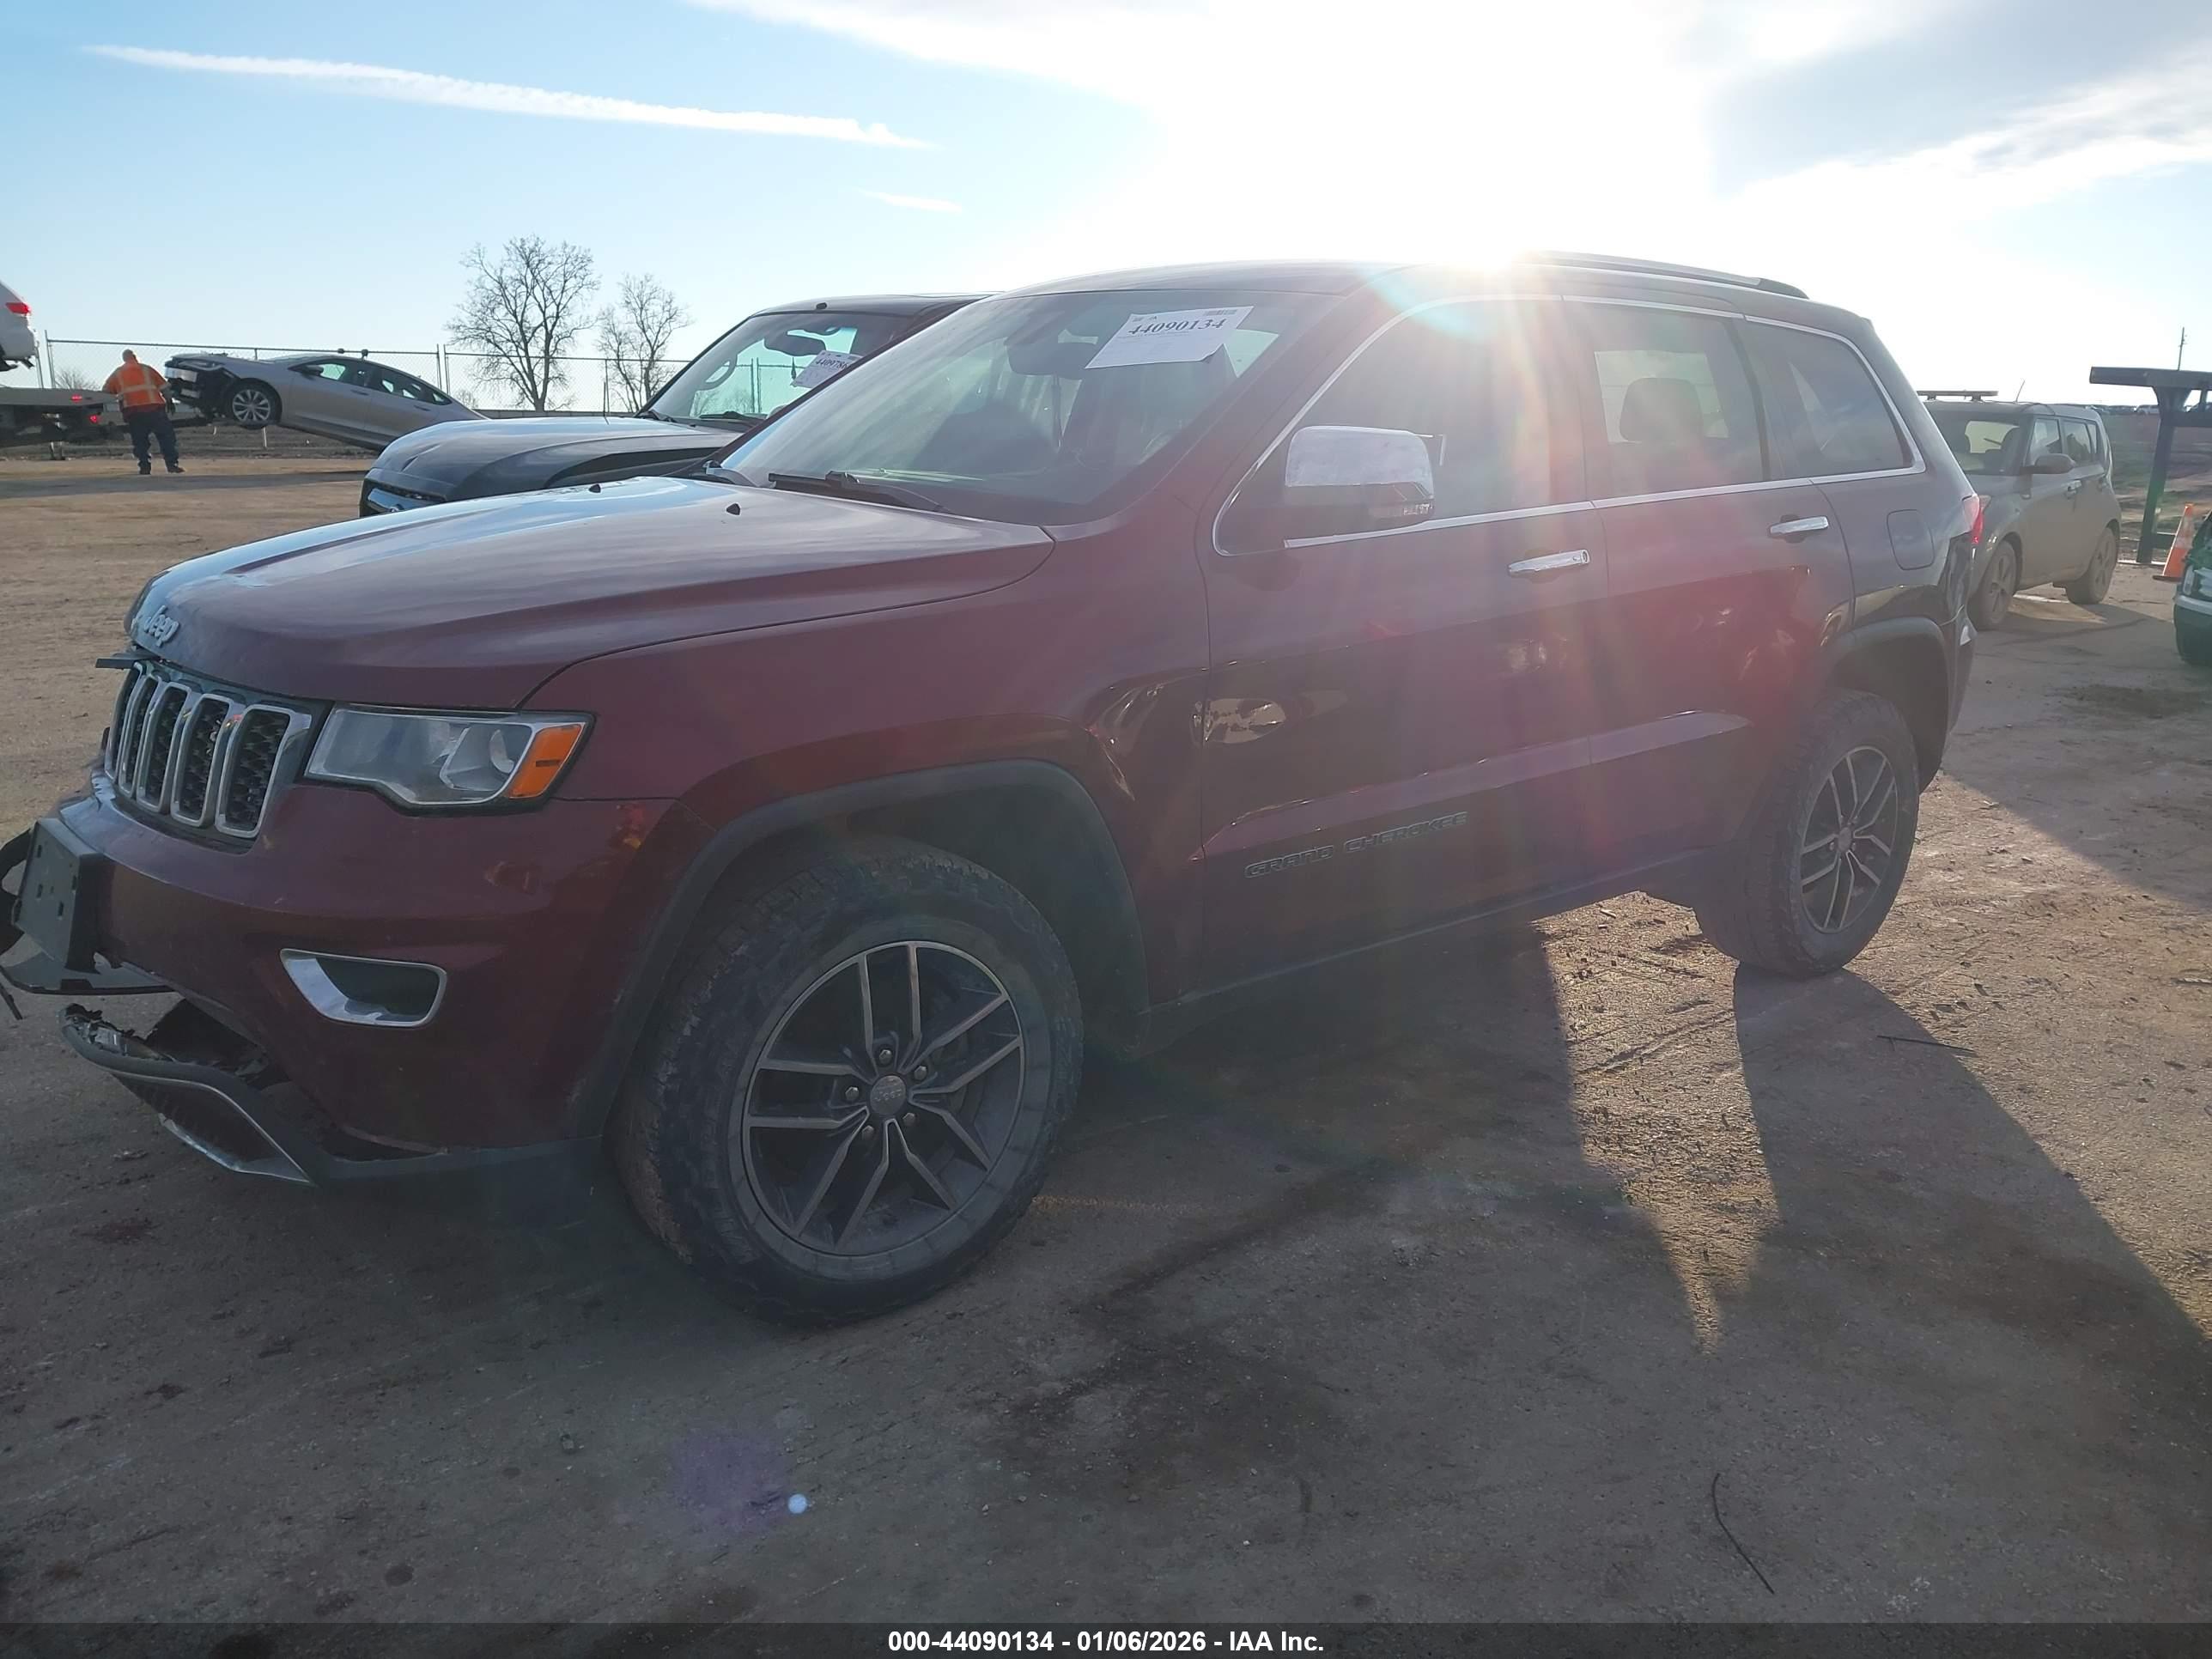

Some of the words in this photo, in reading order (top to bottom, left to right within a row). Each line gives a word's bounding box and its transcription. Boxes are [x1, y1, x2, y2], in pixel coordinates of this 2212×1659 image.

[1127, 318, 1227, 335] 44090134
[143, 605, 179, 647] Jeep
[1244, 845, 1334, 878] GRAND
[1344, 811, 1468, 853] CHEROKEE
